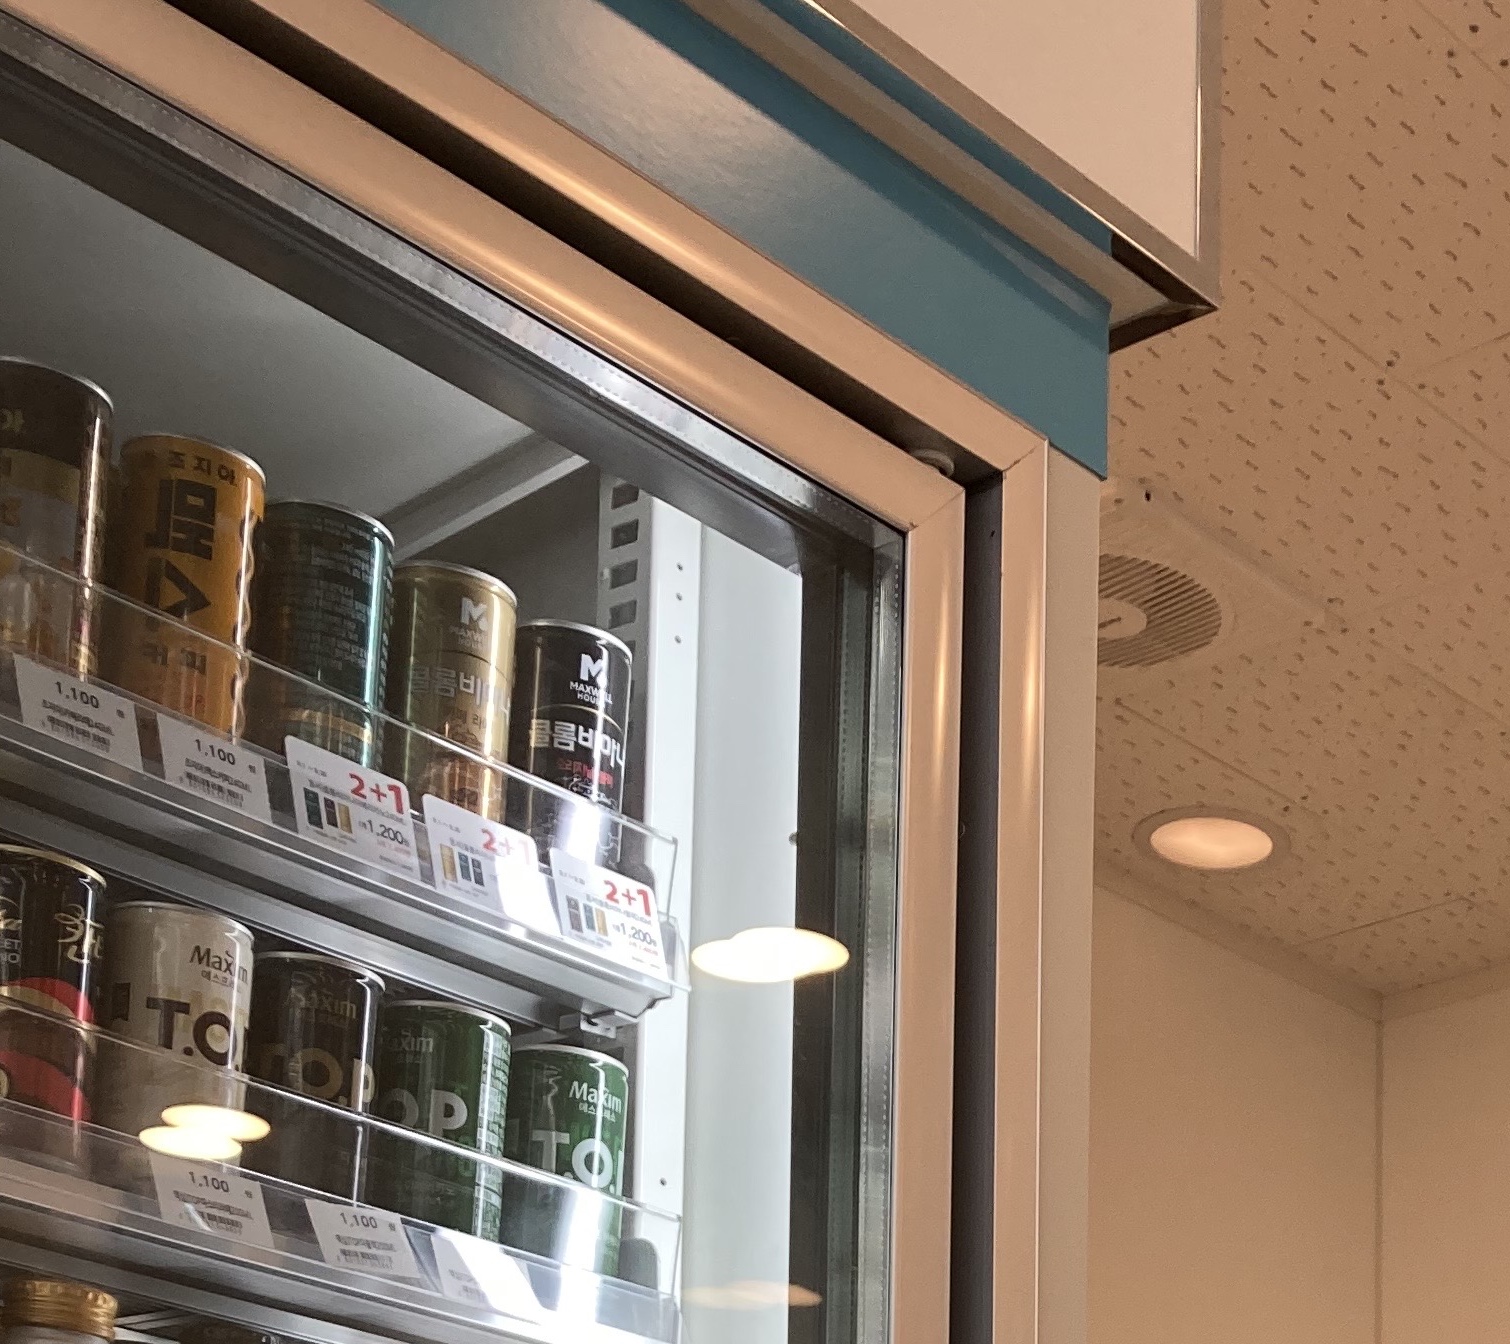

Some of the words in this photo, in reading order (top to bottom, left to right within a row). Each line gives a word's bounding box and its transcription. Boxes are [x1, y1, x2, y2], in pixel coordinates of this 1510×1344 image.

[569, 681, 613, 706] MAXWLL
[348, 772, 404, 816] 2+1
[604, 879, 651, 918] 2+1
[189, 944, 248, 985] Maxm
